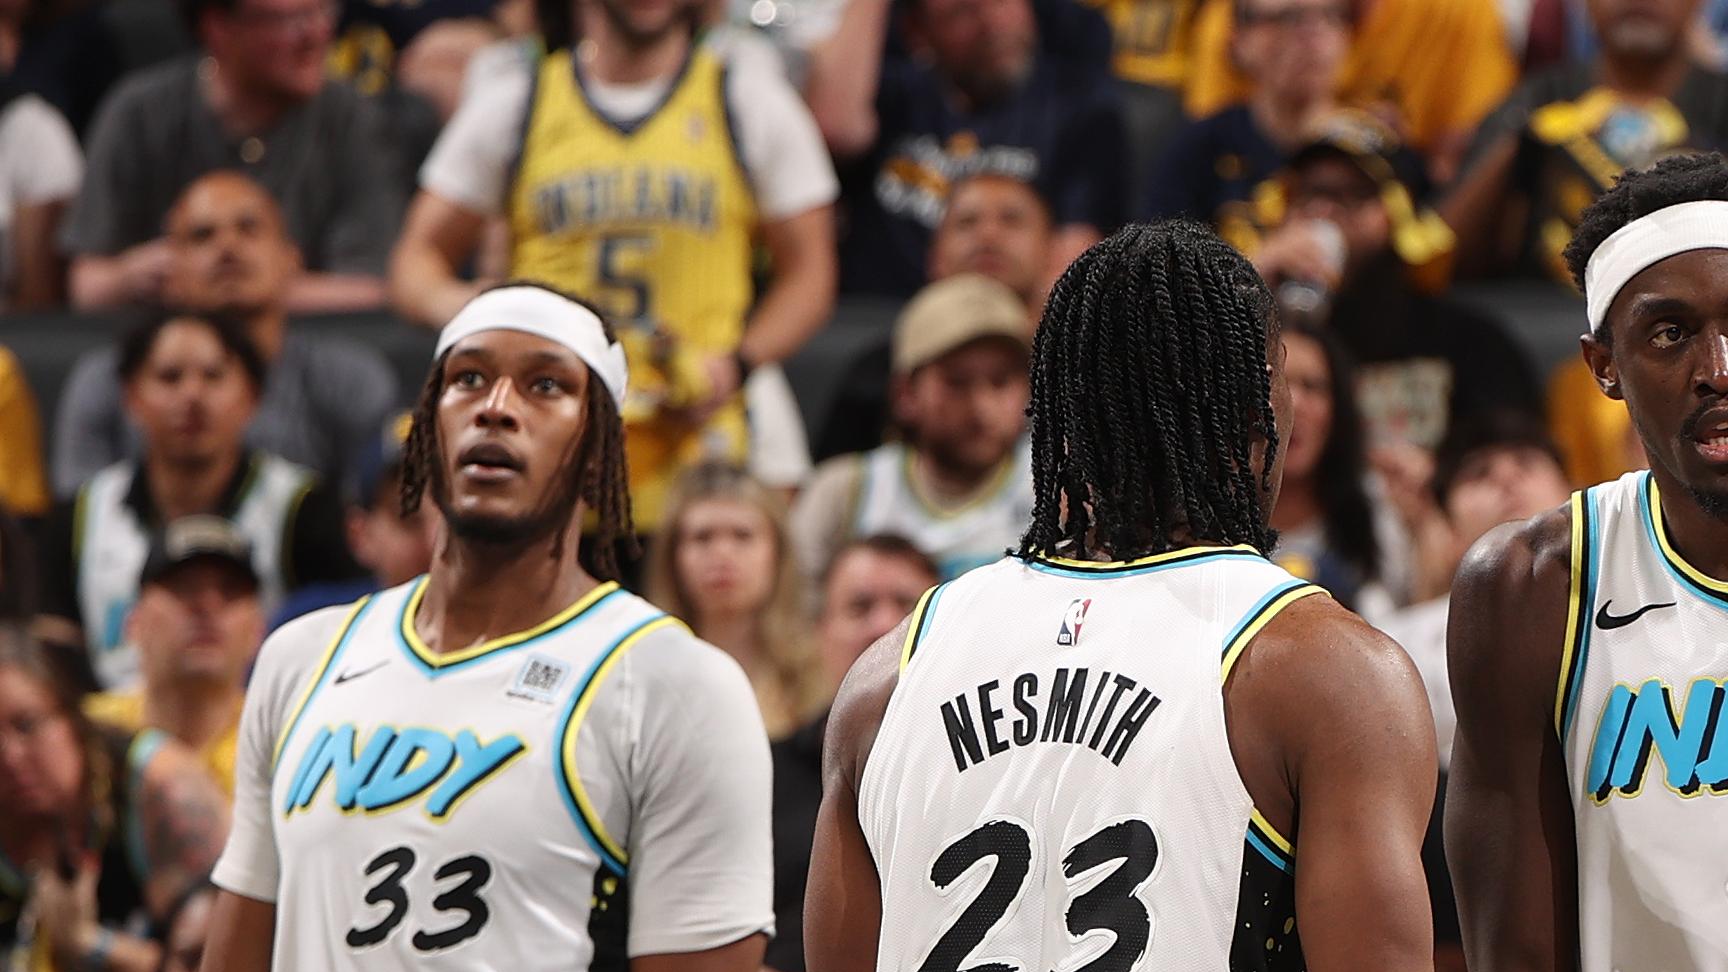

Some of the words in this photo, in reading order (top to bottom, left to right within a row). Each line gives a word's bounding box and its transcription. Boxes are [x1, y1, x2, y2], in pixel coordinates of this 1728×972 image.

[940, 667, 1162, 774] NESMITH
[284, 723, 531, 828] INDY
[346, 846, 492, 951] 33
